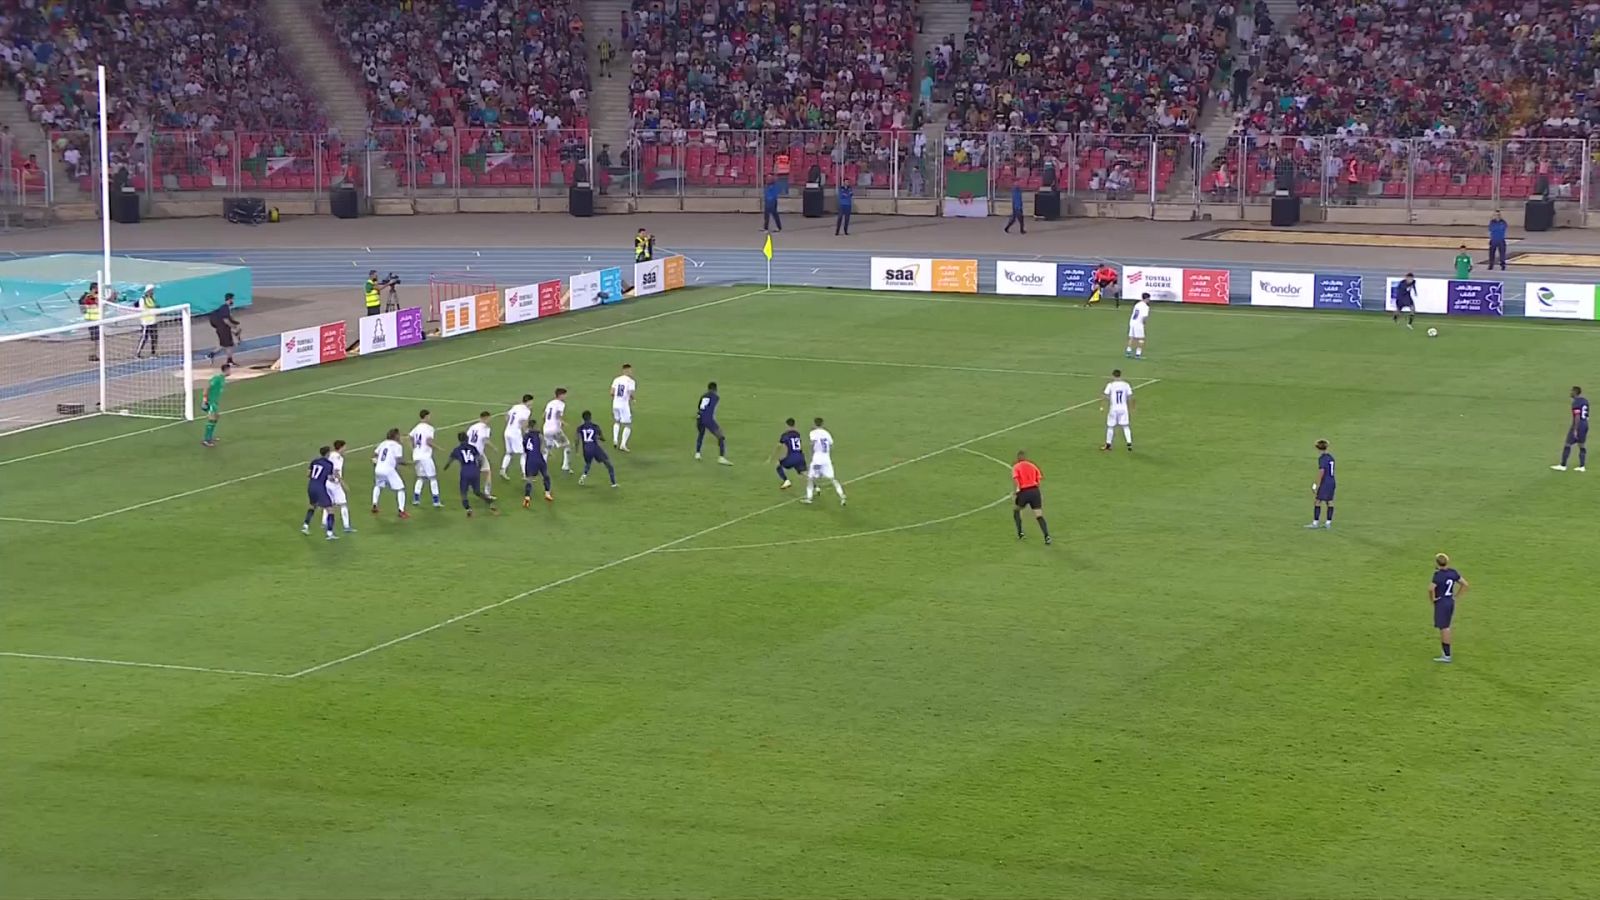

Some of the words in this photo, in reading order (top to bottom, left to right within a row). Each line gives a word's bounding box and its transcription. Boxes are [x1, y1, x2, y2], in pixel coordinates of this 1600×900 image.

[643, 271, 656, 285] saa
[885, 269, 914, 281] saa
[1009, 272, 1045, 283] Condor
[1264, 282, 1302, 294] Condor
[415, 433, 423, 448] 14
[582, 429, 594, 442] 12
[790, 437, 801, 450] 13
[311, 464, 323, 480] 17
[1445, 579, 1454, 596] 2
